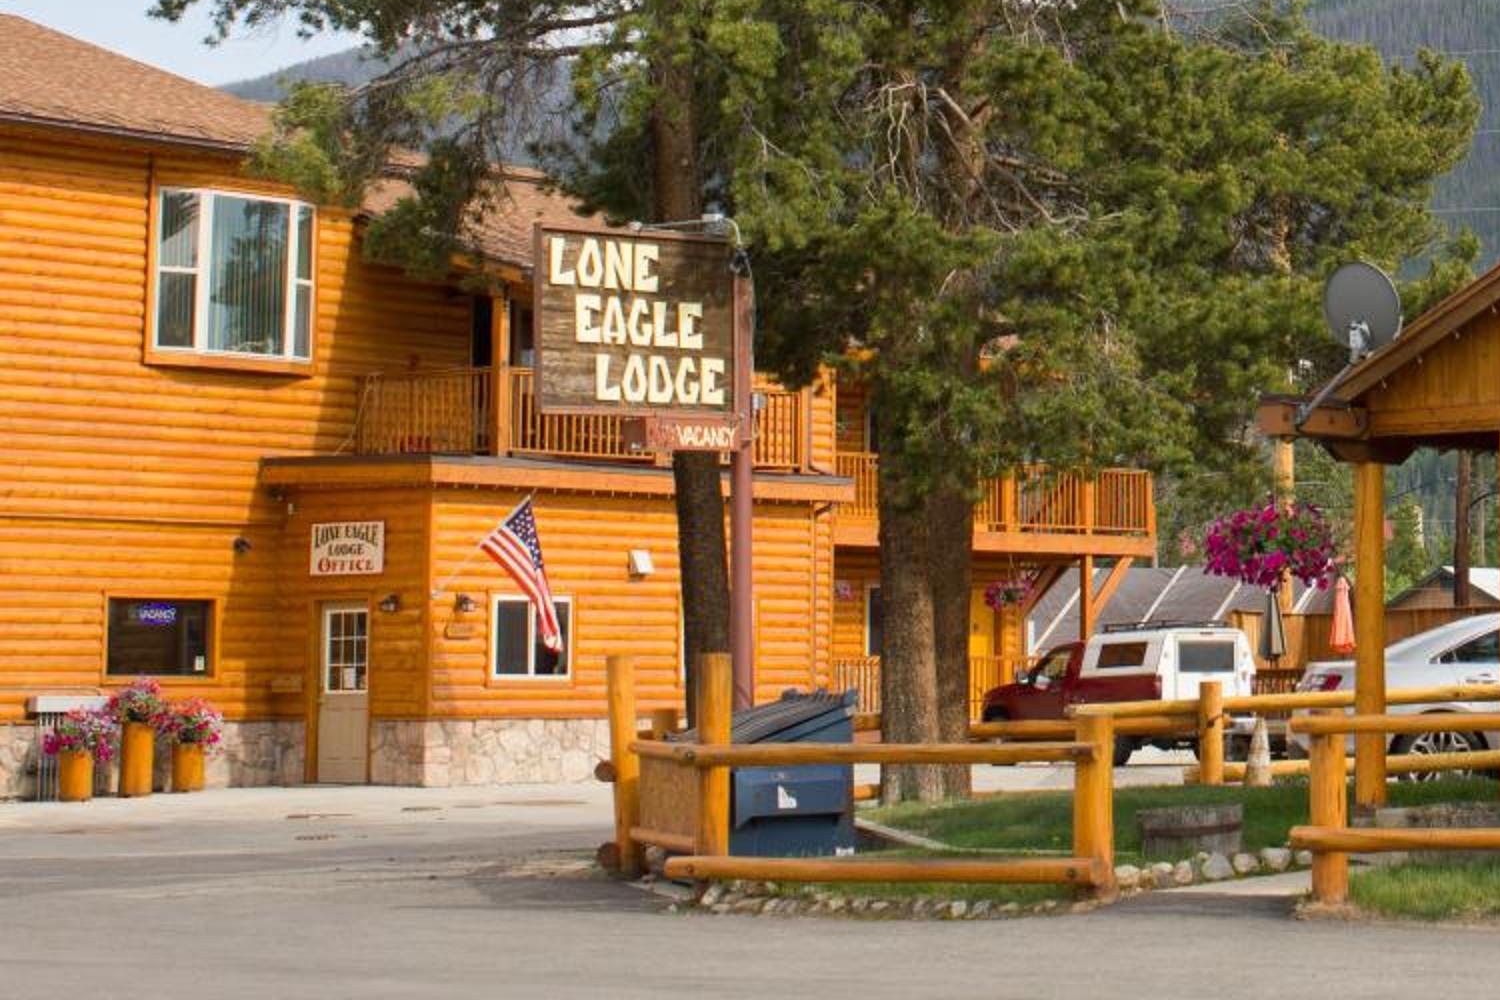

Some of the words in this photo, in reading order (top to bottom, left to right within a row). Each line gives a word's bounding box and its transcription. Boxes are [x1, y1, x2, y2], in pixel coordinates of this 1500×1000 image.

[549, 237, 660, 293] LONE
[575, 293, 703, 350] EAGLE
[595, 353, 726, 405] LODGE
[676, 424, 736, 449] VACANCY
[315, 525, 341, 548] LONE
[327, 543, 365, 557] LODGE
